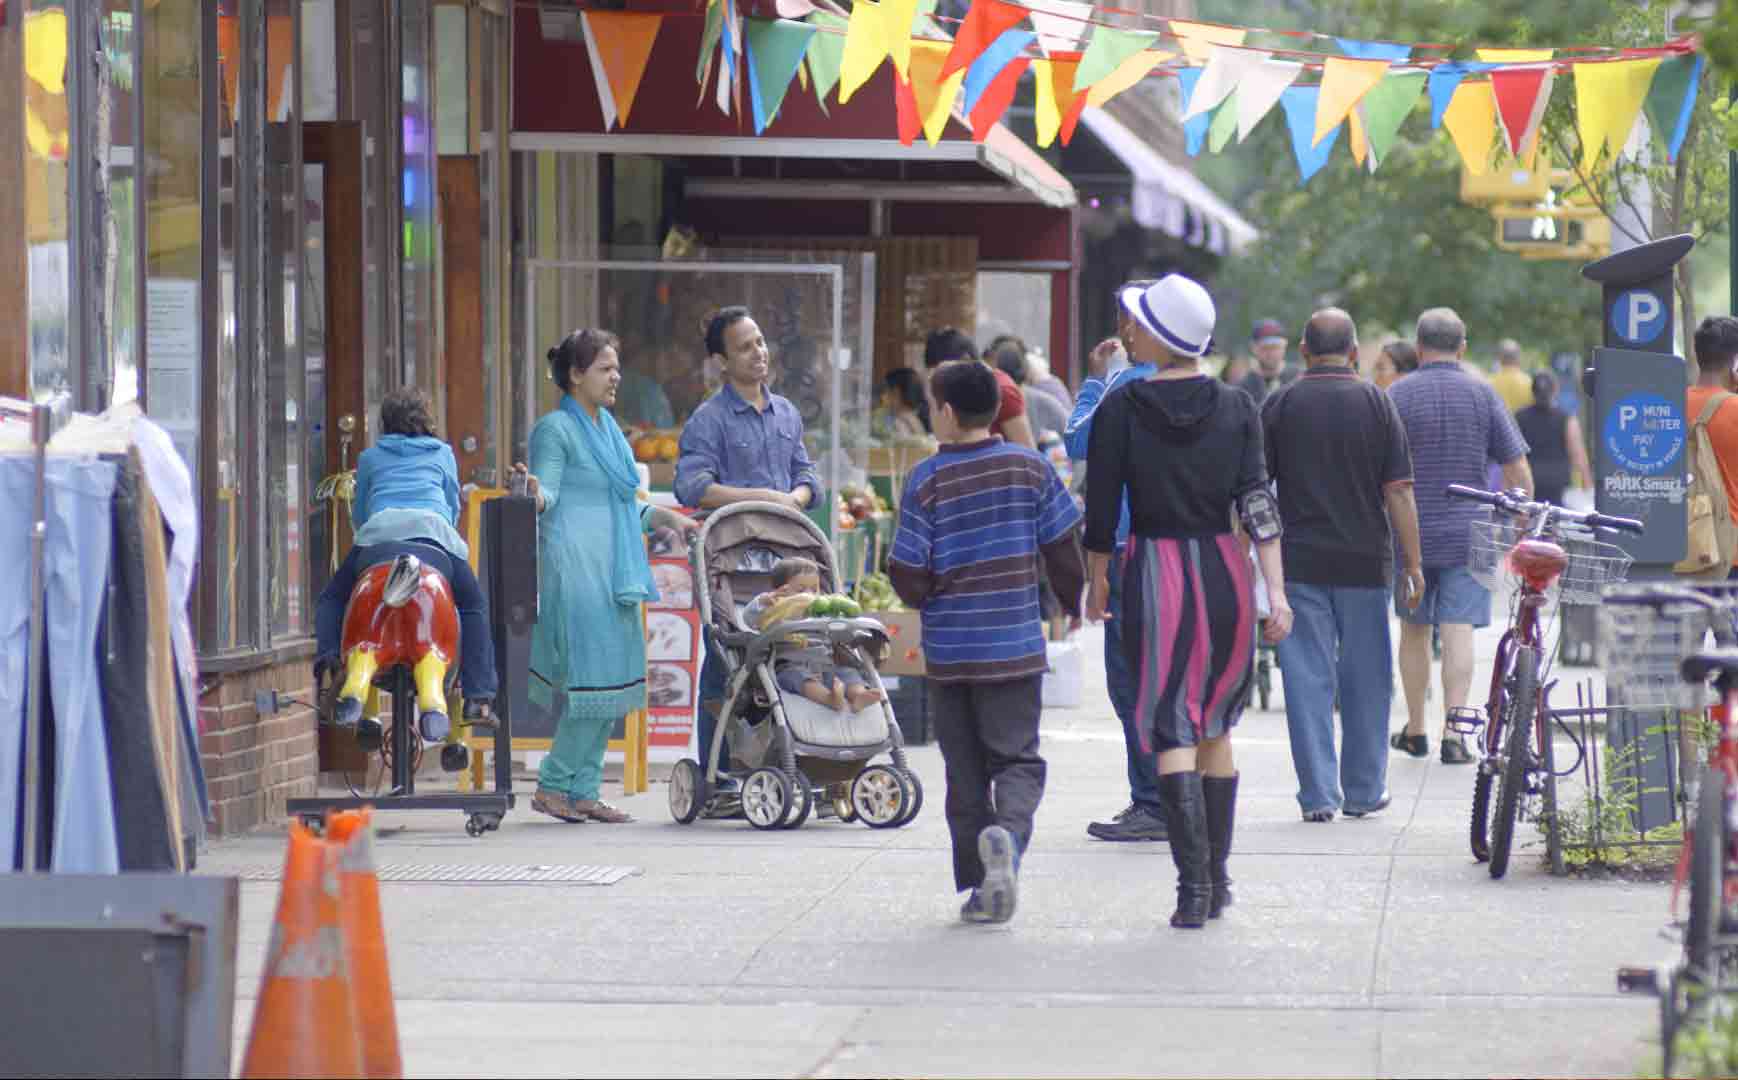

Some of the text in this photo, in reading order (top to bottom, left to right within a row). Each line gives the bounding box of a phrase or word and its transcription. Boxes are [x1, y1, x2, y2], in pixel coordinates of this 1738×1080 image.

[1629, 293, 1659, 340] P
[1620, 404, 1637, 431] P
[1644, 418, 1681, 430] TER
[1605, 476, 1642, 491] PARK
